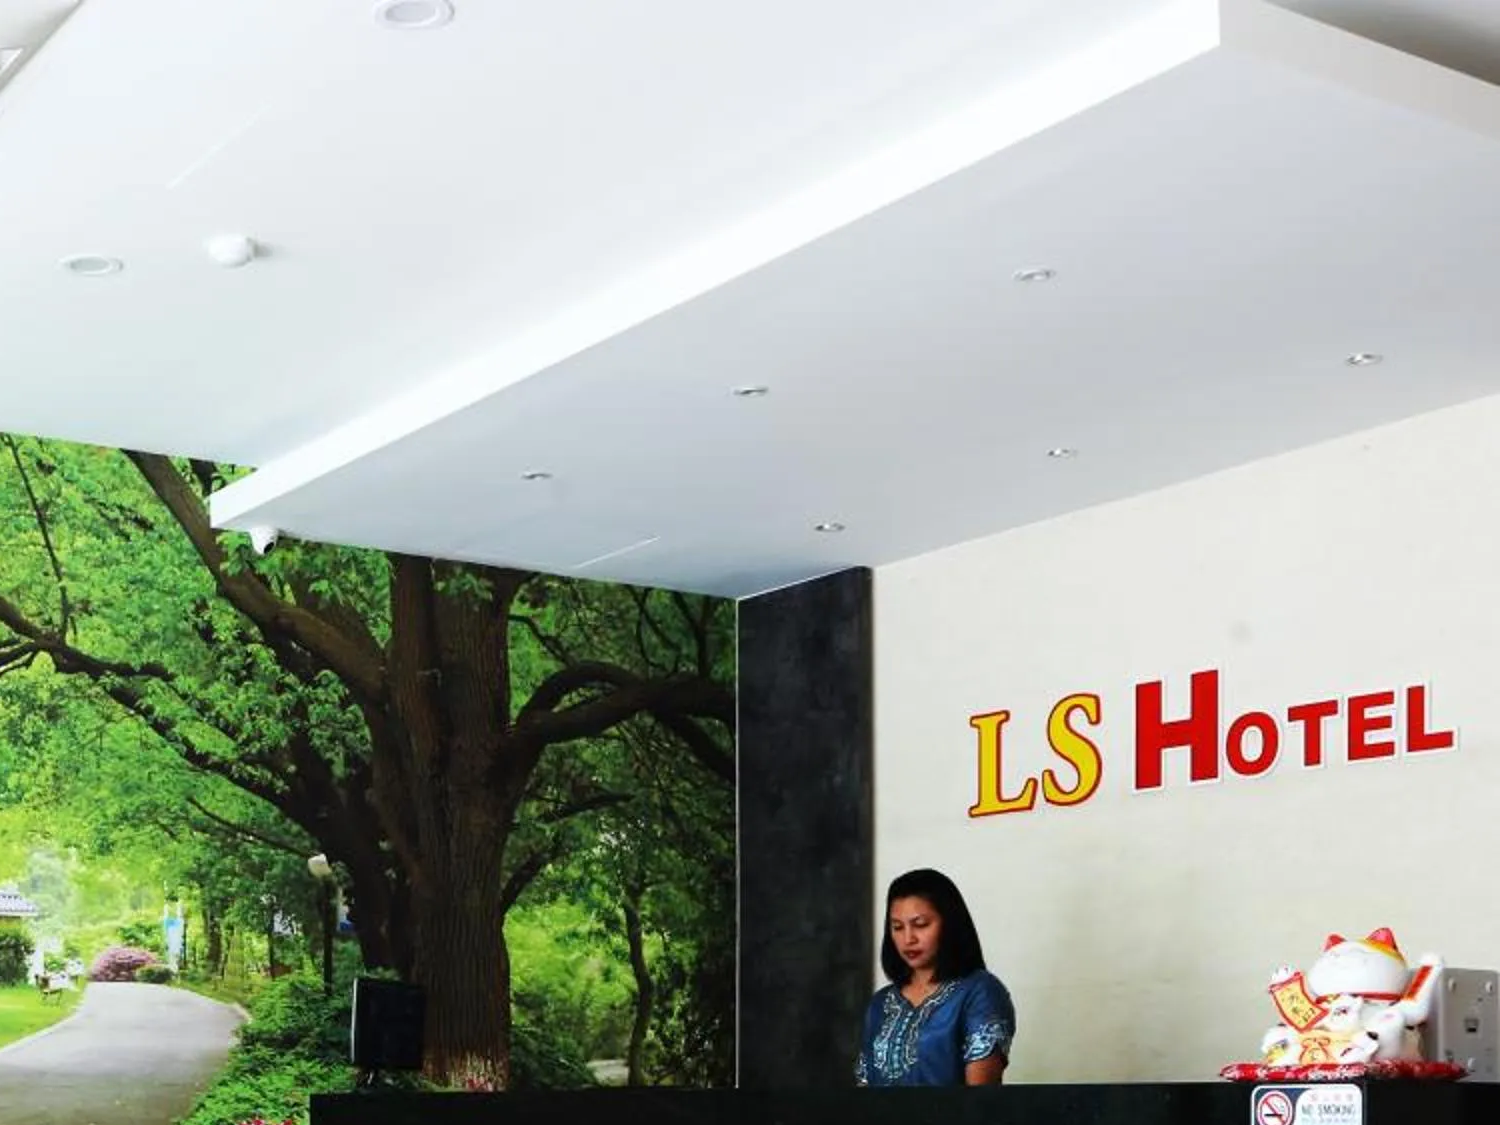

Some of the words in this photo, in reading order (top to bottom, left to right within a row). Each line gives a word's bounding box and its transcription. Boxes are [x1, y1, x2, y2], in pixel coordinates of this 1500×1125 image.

[968, 692, 1102, 818] LS
[1134, 668, 1455, 791] HOTEL
[1317, 1103, 1356, 1116] SMOKING
